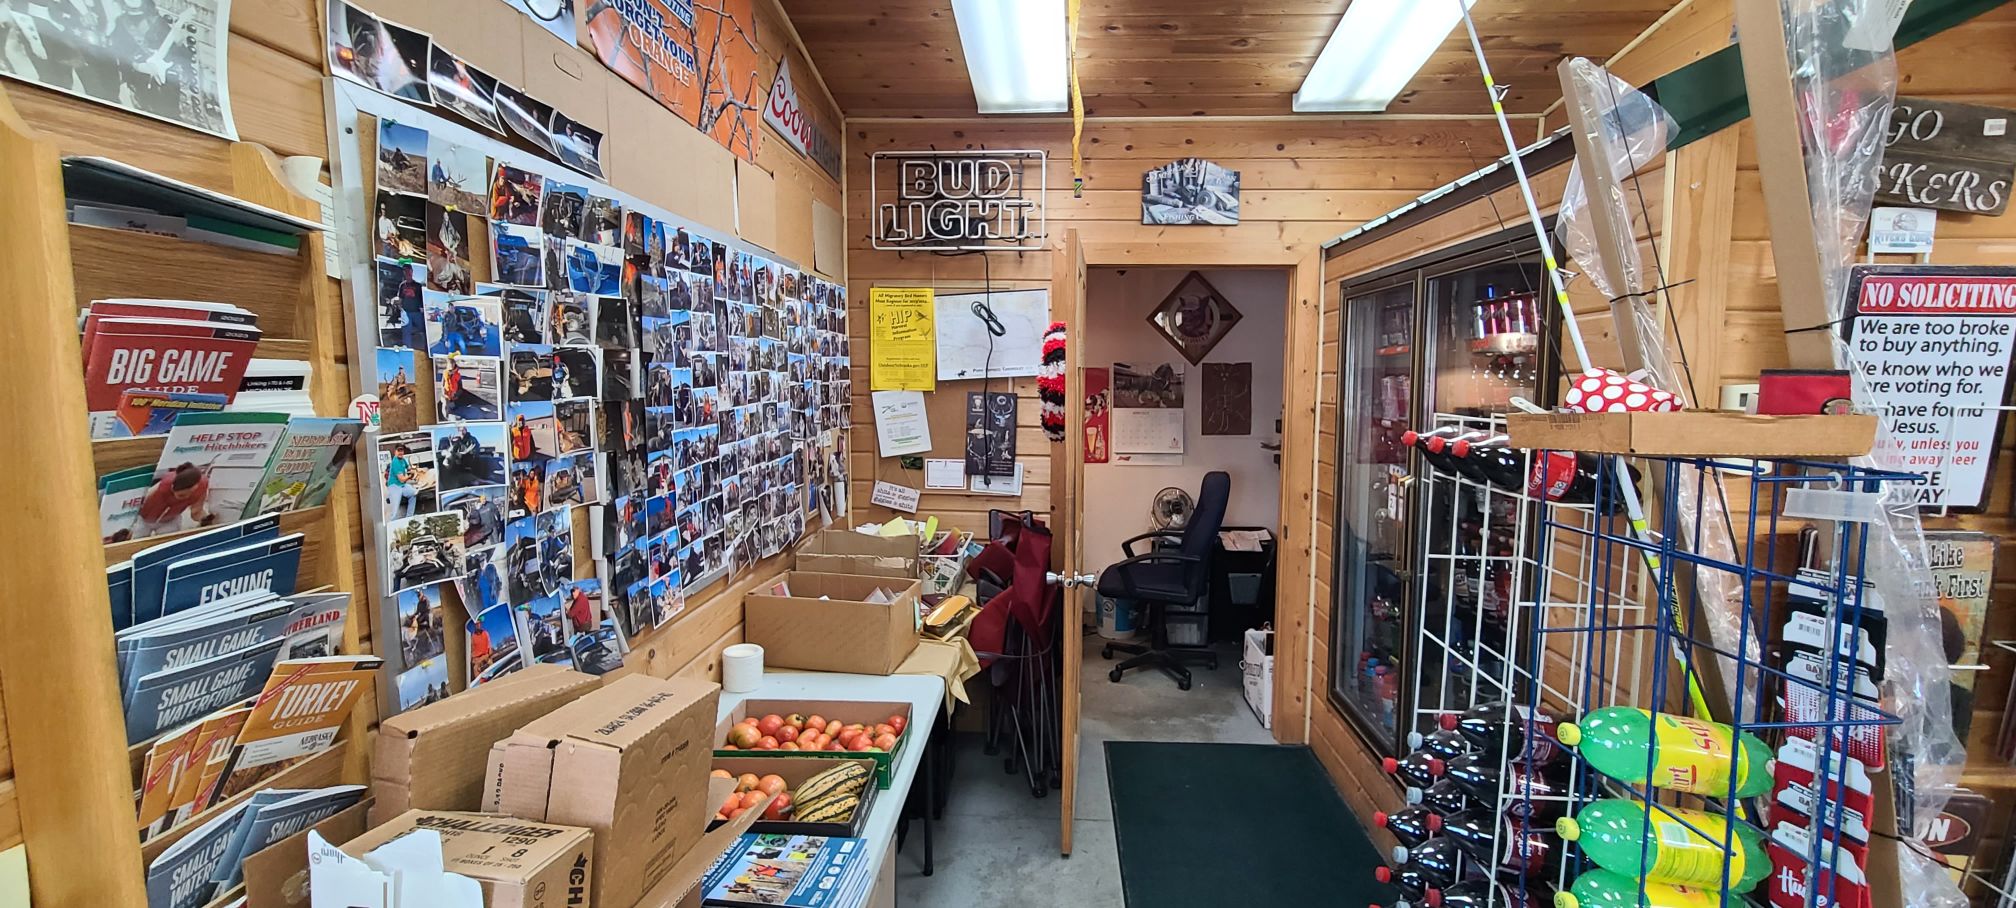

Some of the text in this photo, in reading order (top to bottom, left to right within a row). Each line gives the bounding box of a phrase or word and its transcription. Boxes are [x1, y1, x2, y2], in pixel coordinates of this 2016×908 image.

[630, 0, 665, 29] ON'T
[605, 0, 696, 74] ORGET YOUR
[629, 23, 690, 88] ORANGE
[1884, 105, 1945, 147] GO
[902, 159, 1013, 199] BUD
[1870, 162, 2007, 211] SKERS
[879, 203, 1035, 241] LIGHT
[1861, 282, 2016, 309] NO SOLICITING
[890, 309, 913, 325] HIP
[1860, 319, 2010, 336] We are too broke
[1859, 336, 2002, 357] to buy anything.
[106, 348, 234, 385] BIG GAME
[1881, 361, 1931, 376] know
[1936, 361, 1974, 376] who
[1979, 364, 2004, 376] we
[1895, 379, 1951, 397] voting
[1956, 378, 1983, 394] for.
[356, 402, 380, 426] N
[1891, 418, 1940, 434] Jesus.
[189, 431, 262, 443] HELP STOP
[204, 441, 269, 451] Hitchhikers
[1955, 440, 1979, 453] you
[1909, 455, 1944, 468] away
[1950, 456, 1977, 466] eer
[1930, 543, 1963, 567] Like
[200, 568, 274, 606] FISHING
[1946, 574, 1984, 597] First
[162, 638, 218, 672] SMALL
[156, 680, 246, 730] WATERFOWL
[157, 674, 214, 711] SMALL
[269, 679, 360, 721] TURKEY
[272, 714, 326, 730] GUIDE
[434, 814, 565, 839] CHALLENGER
[482, 846, 529, 858] 1 8
[501, 836, 539, 846] 1290
[169, 843, 210, 891] SMALL
[170, 857, 222, 908] WATERF
